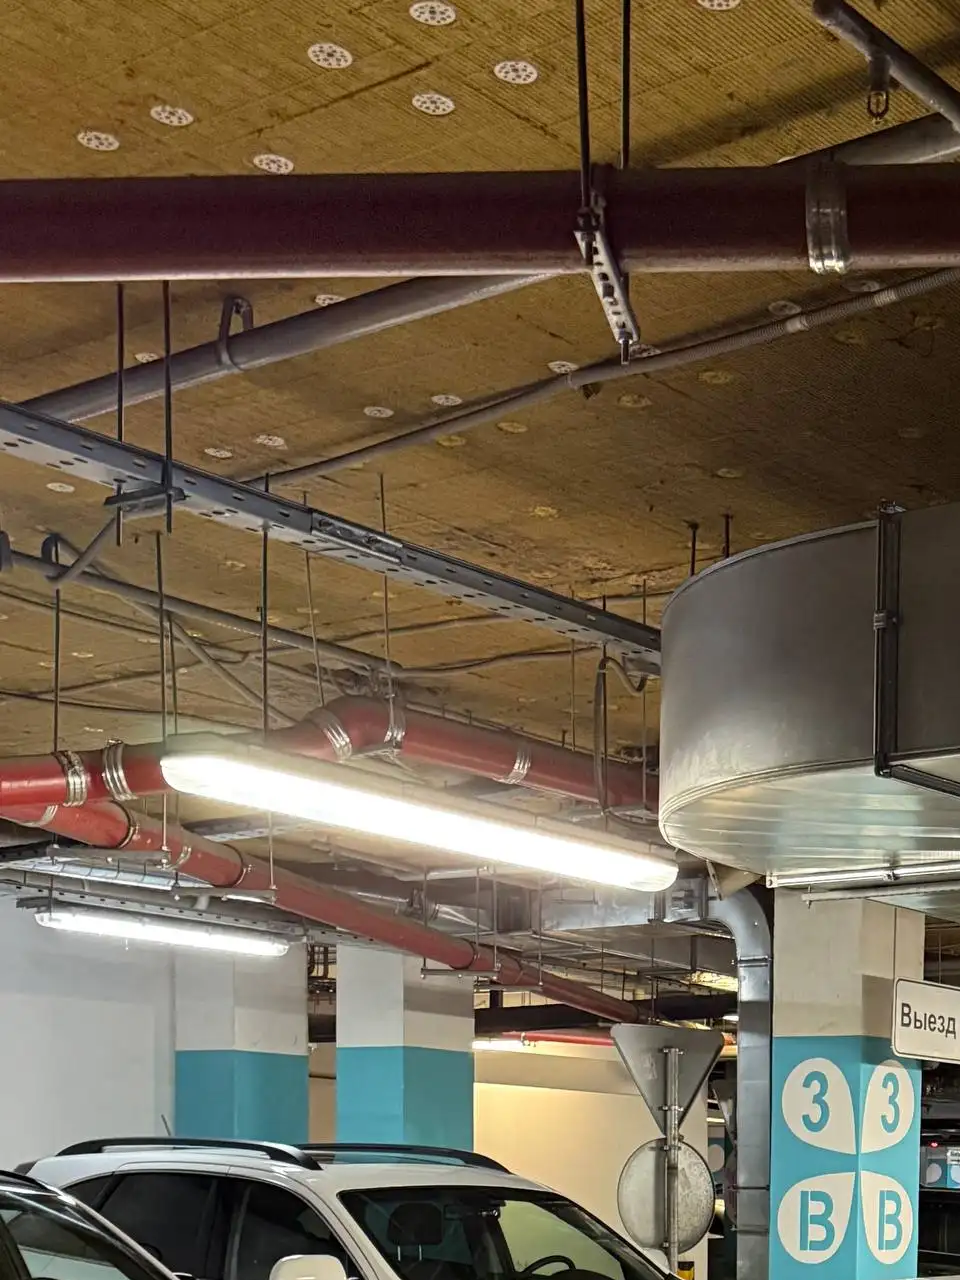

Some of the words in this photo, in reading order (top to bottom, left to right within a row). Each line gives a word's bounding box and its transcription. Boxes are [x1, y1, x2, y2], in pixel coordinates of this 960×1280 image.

[900, 1002, 957, 1040] Выезд
[801, 1070, 830, 1133] 3
[880, 1072, 900, 1134] 3
